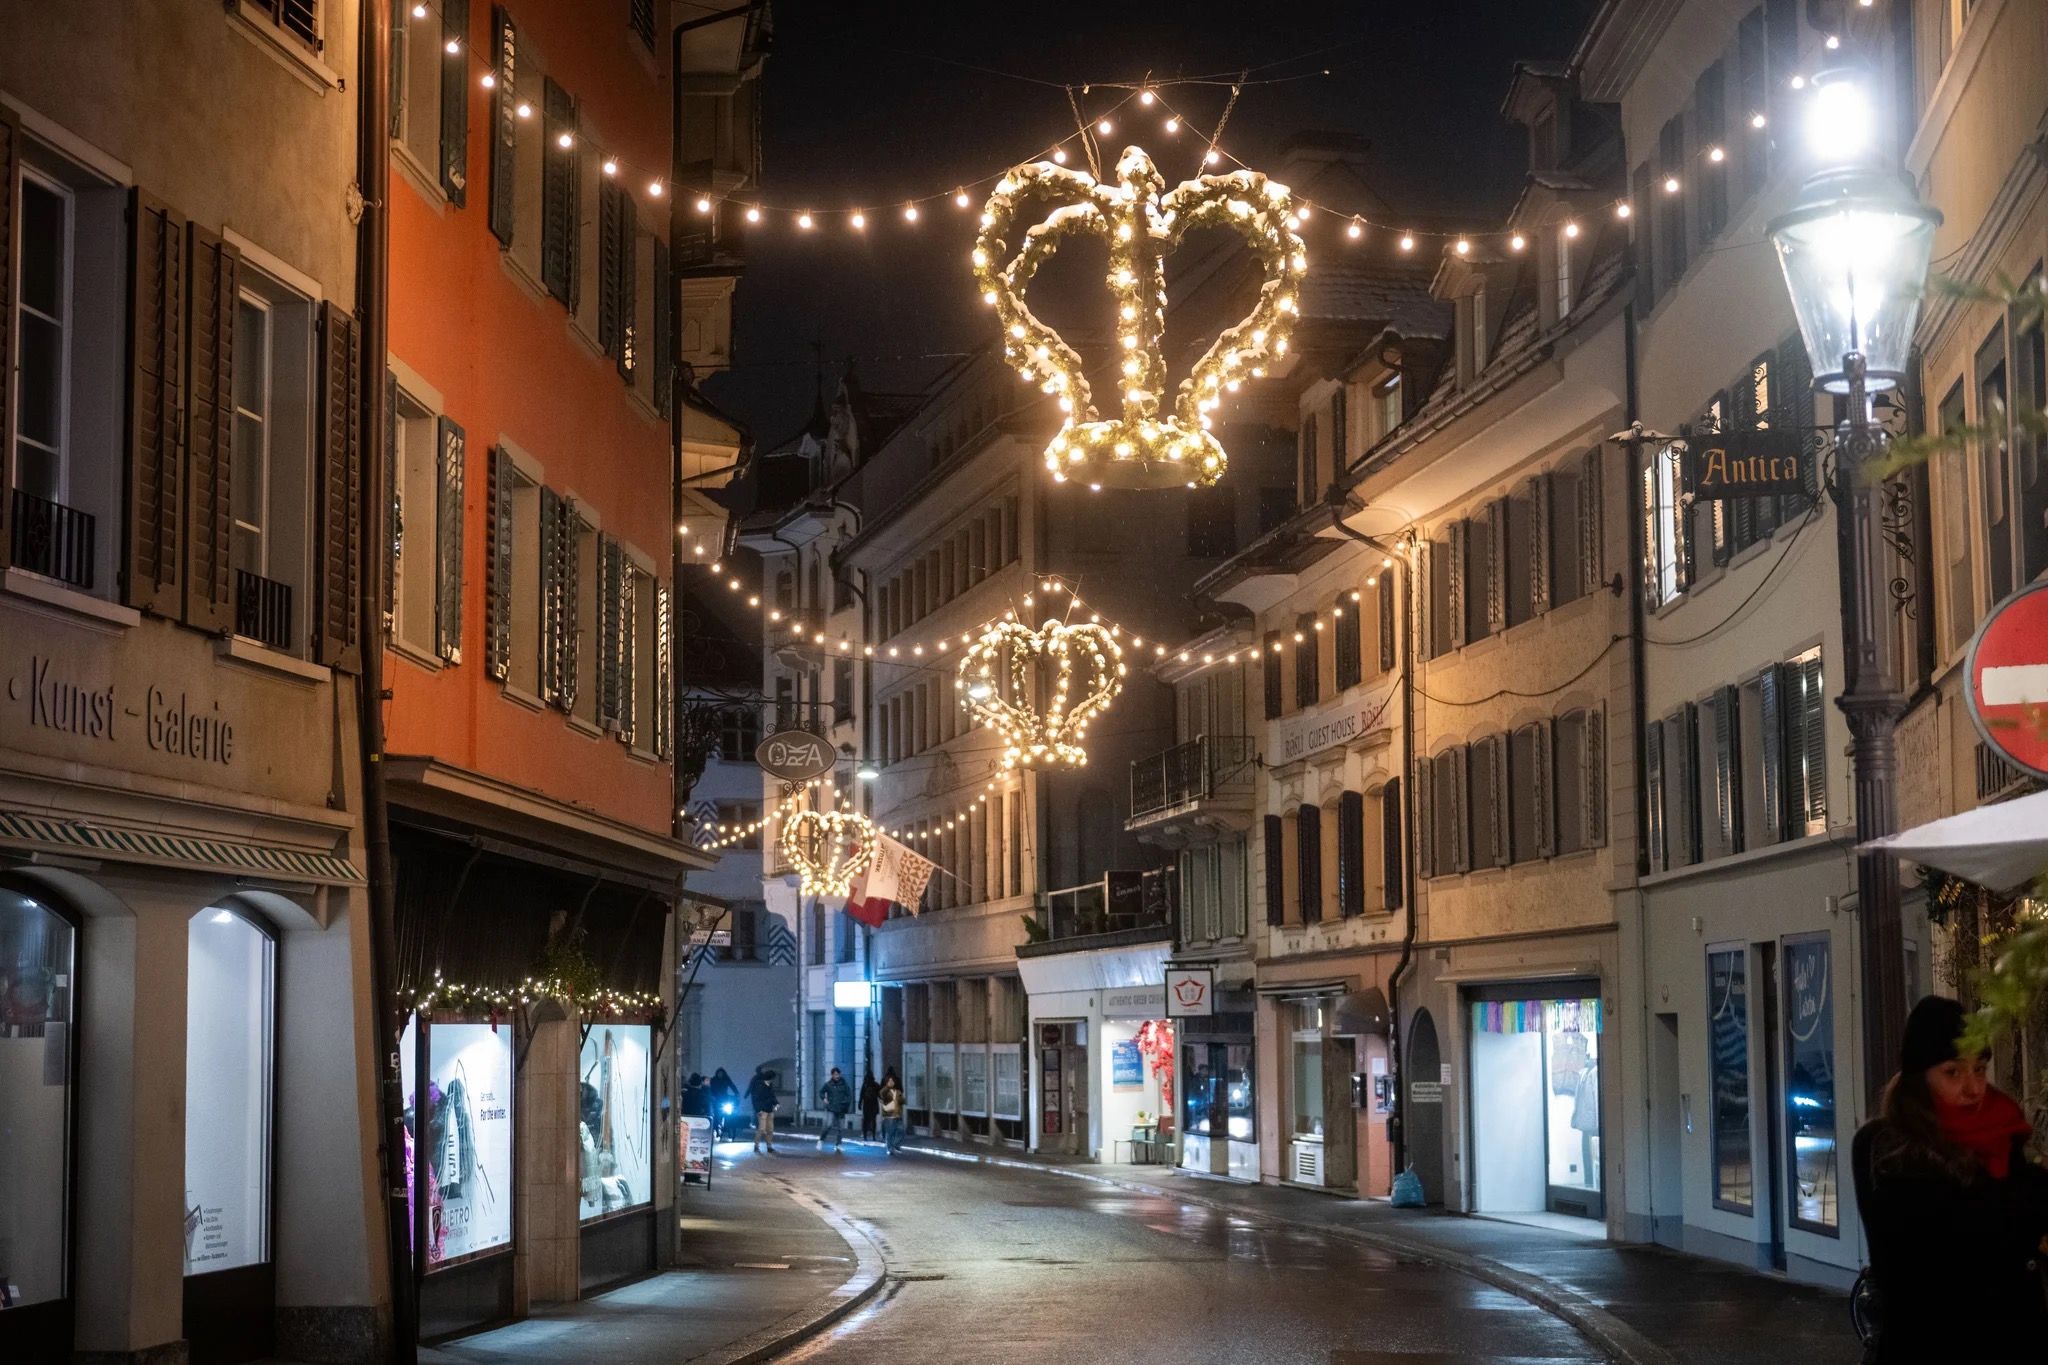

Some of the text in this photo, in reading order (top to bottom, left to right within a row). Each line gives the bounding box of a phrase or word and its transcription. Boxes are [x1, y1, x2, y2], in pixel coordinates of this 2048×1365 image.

[1700, 447, 1799, 486] Antica
[31, 655, 118, 741] Kunst
[146, 683, 234, 765] Galerie
[1308, 724, 1330, 749] GUEST
[1331, 714, 1356, 742] HOUSE
